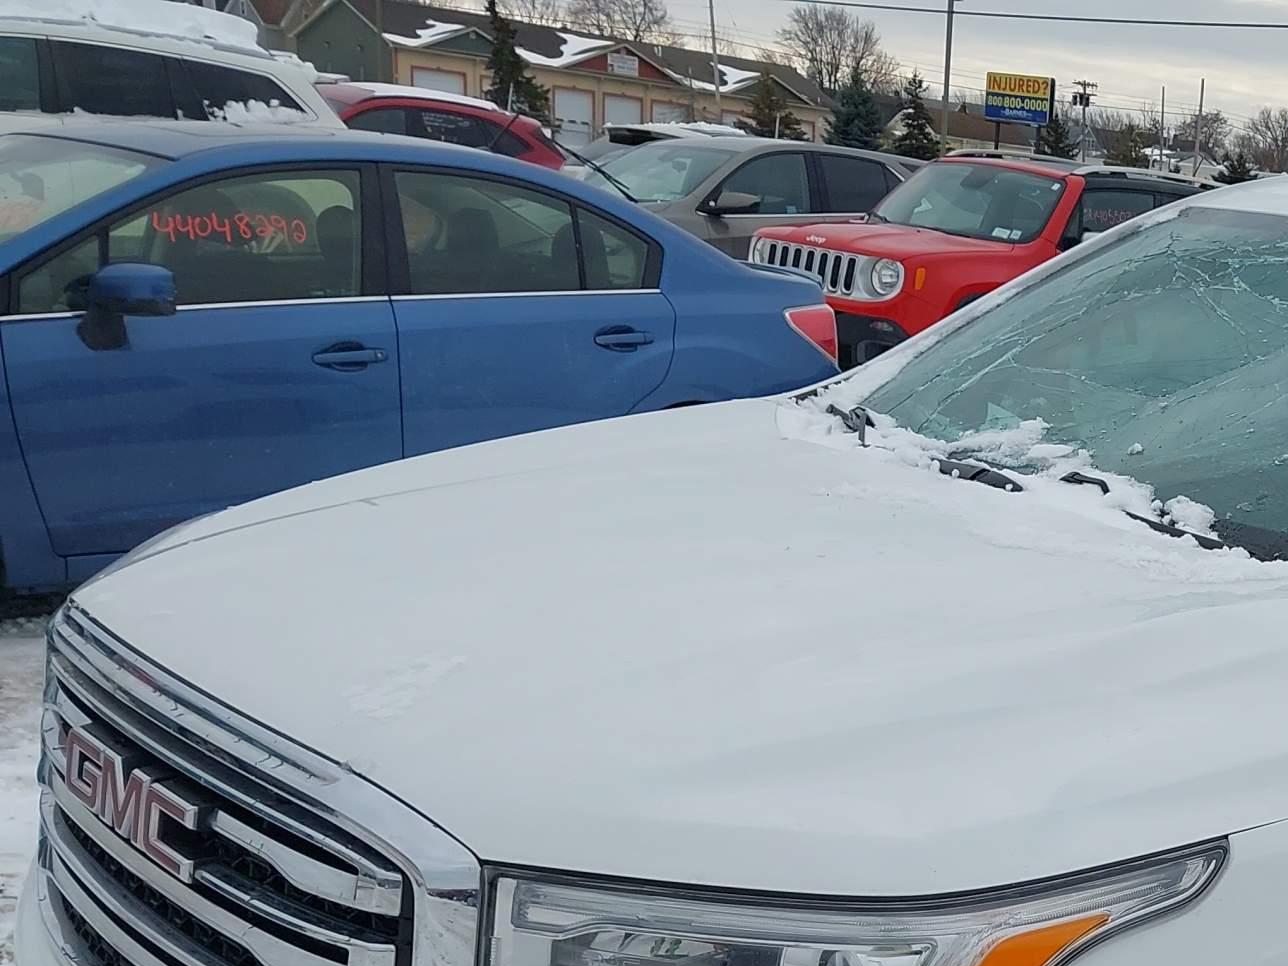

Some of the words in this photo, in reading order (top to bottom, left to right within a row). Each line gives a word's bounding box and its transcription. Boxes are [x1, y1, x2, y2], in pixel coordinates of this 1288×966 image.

[988, 75, 1049, 96] INJURED?
[988, 95, 1002, 106] 800
[1003, 96, 1048, 112] 800-0000
[806, 234, 827, 245] Jeep
[65, 725, 198, 885] GMC
